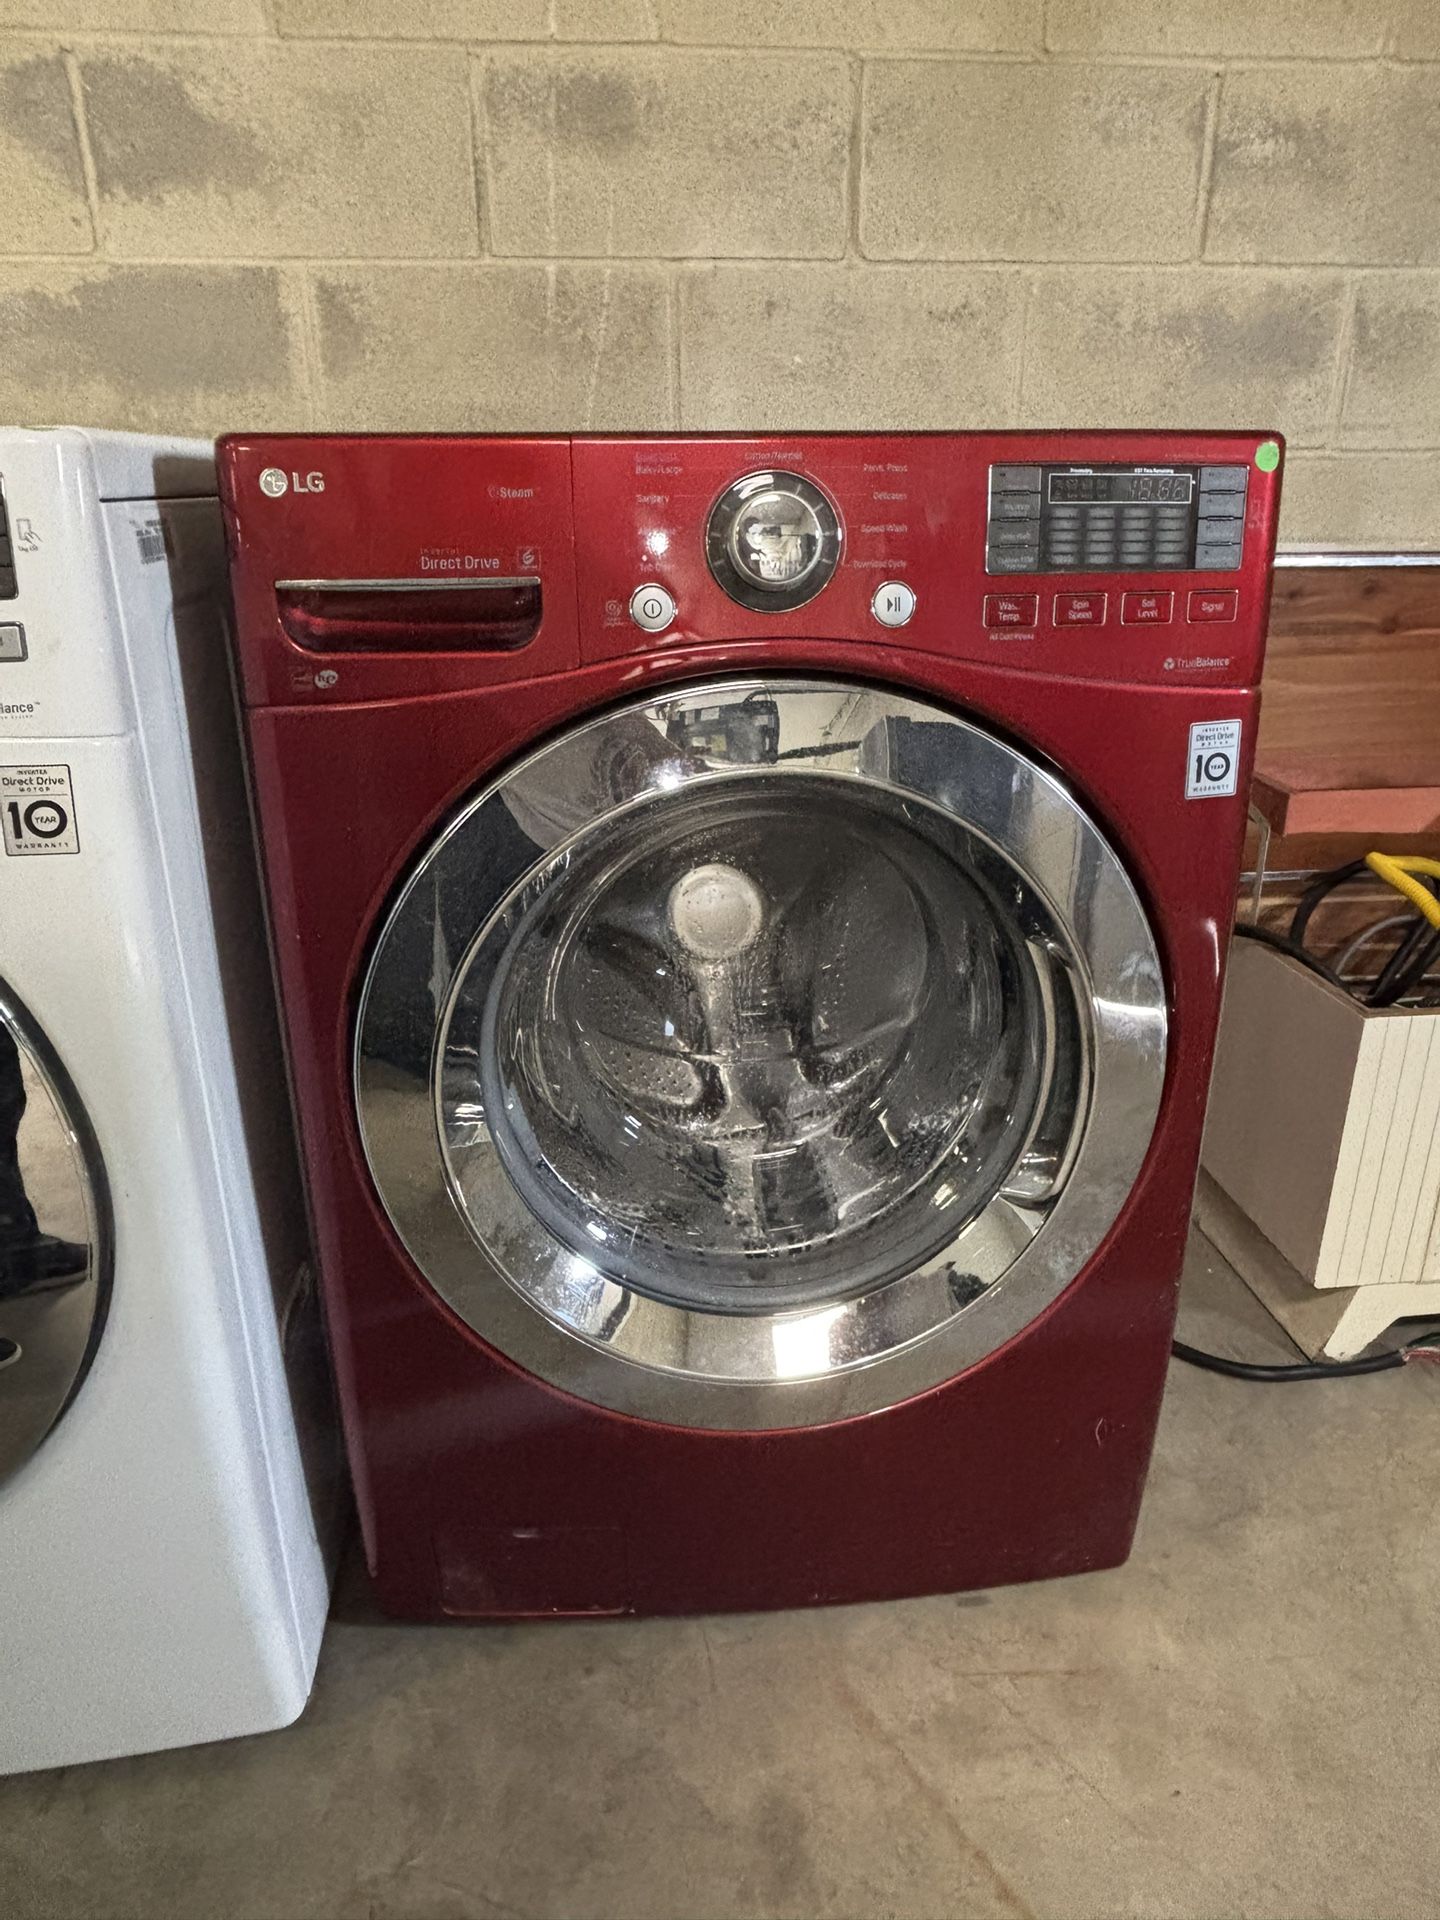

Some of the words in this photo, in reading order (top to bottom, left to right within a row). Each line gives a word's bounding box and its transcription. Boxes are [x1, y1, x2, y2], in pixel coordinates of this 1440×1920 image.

[292, 471, 325, 493] LG
[500, 486, 534, 499] Steam
[421, 556, 462, 571] Direct
[464, 555, 500, 570] Drive
[1072, 600, 1090, 611] Spin
[1141, 598, 1156, 608] Soil
[1196, 733, 1216, 742] Direct
[1217, 732, 1235, 740] Drive
[1196, 752, 1231, 784] 10
[2, 777, 34, 786] Direct
[36, 776, 65, 785] Drive
[7, 799, 68, 840] 10
[34, 815, 57, 824] YEAR
